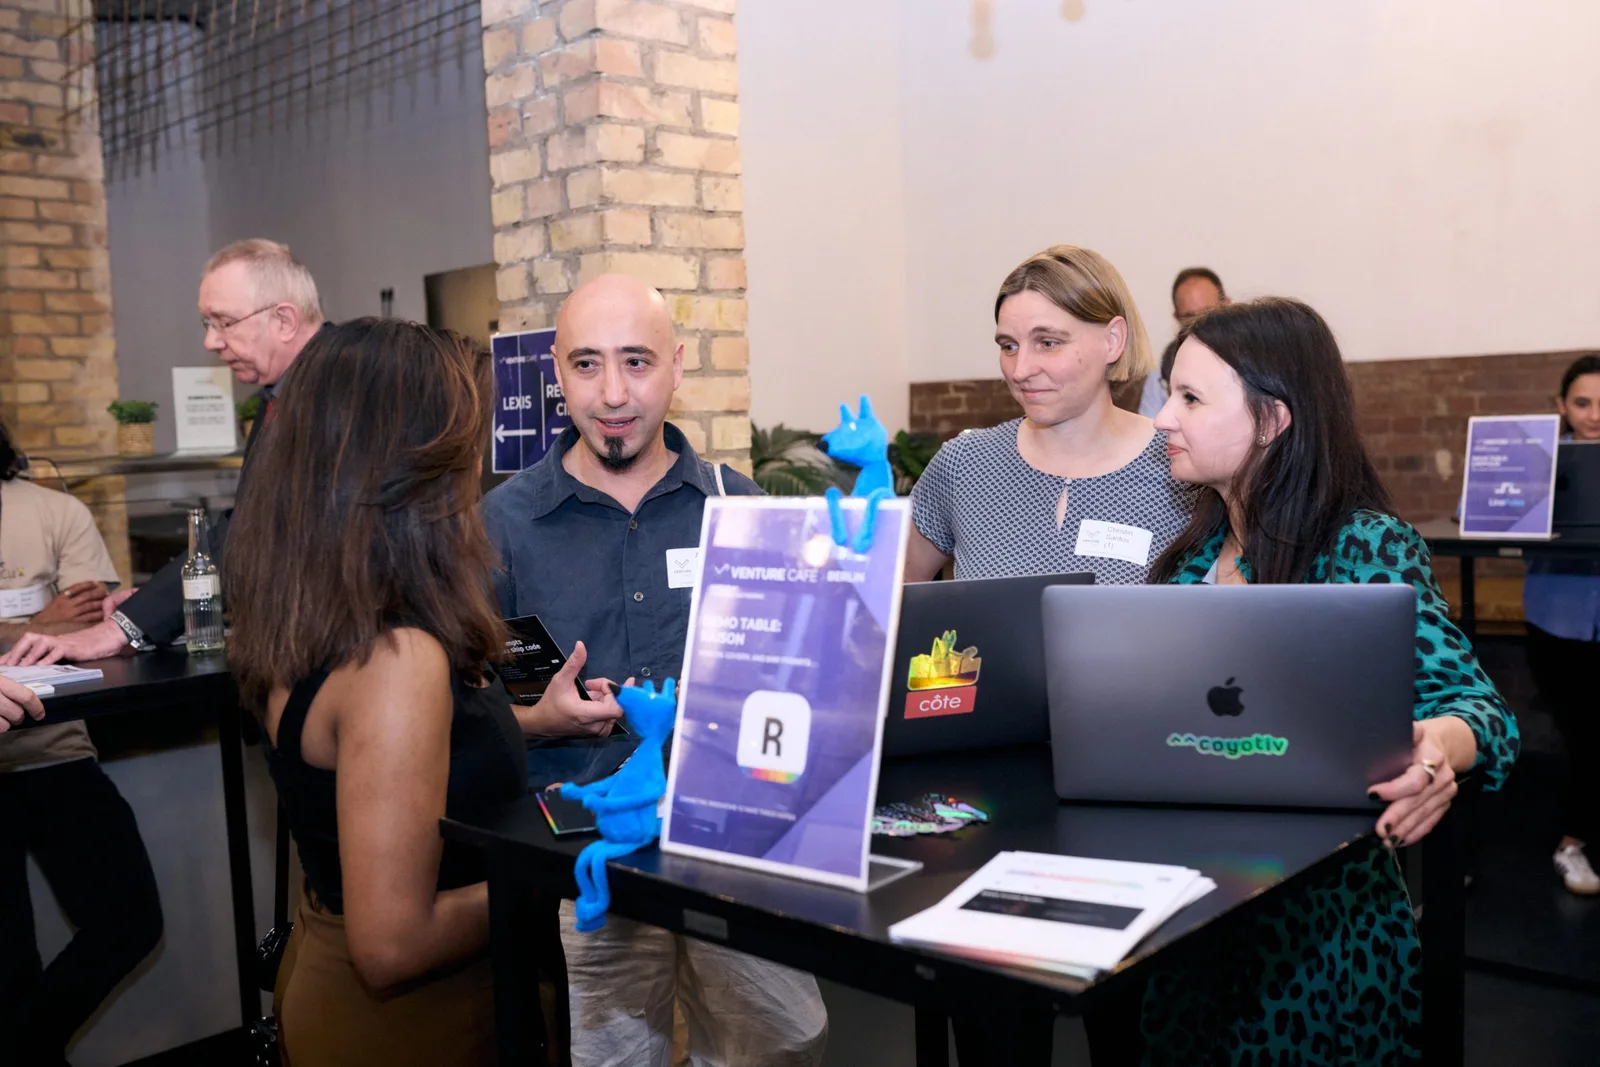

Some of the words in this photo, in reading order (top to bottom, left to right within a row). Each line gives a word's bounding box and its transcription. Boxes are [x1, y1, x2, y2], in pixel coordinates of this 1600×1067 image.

[503, 395, 532, 410] LEXIS
[731, 566, 786, 581] VENTURE
[827, 570, 866, 583] BERLIN
[740, 617, 783, 633] TABLE:
[919, 694, 961, 712] côte
[762, 717, 784, 757] R
